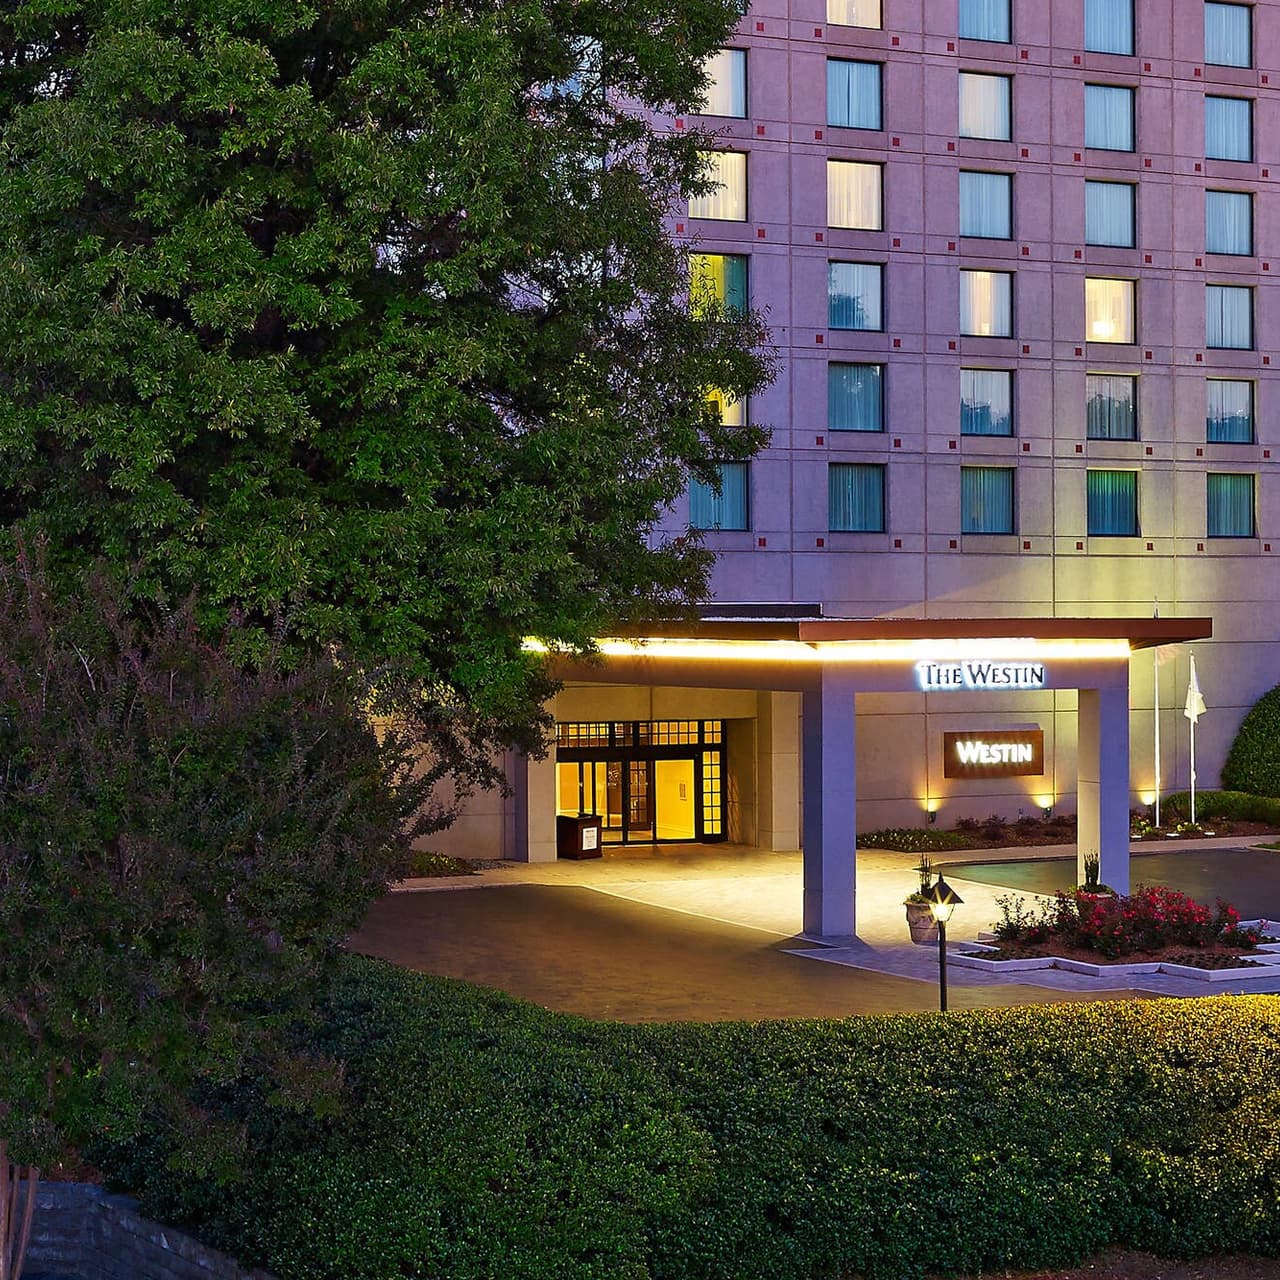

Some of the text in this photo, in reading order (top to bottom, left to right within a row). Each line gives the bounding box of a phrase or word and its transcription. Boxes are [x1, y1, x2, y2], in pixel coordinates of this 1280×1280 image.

[921, 663, 1044, 685] THE WESTIN
[956, 741, 1033, 764] WESTIN
